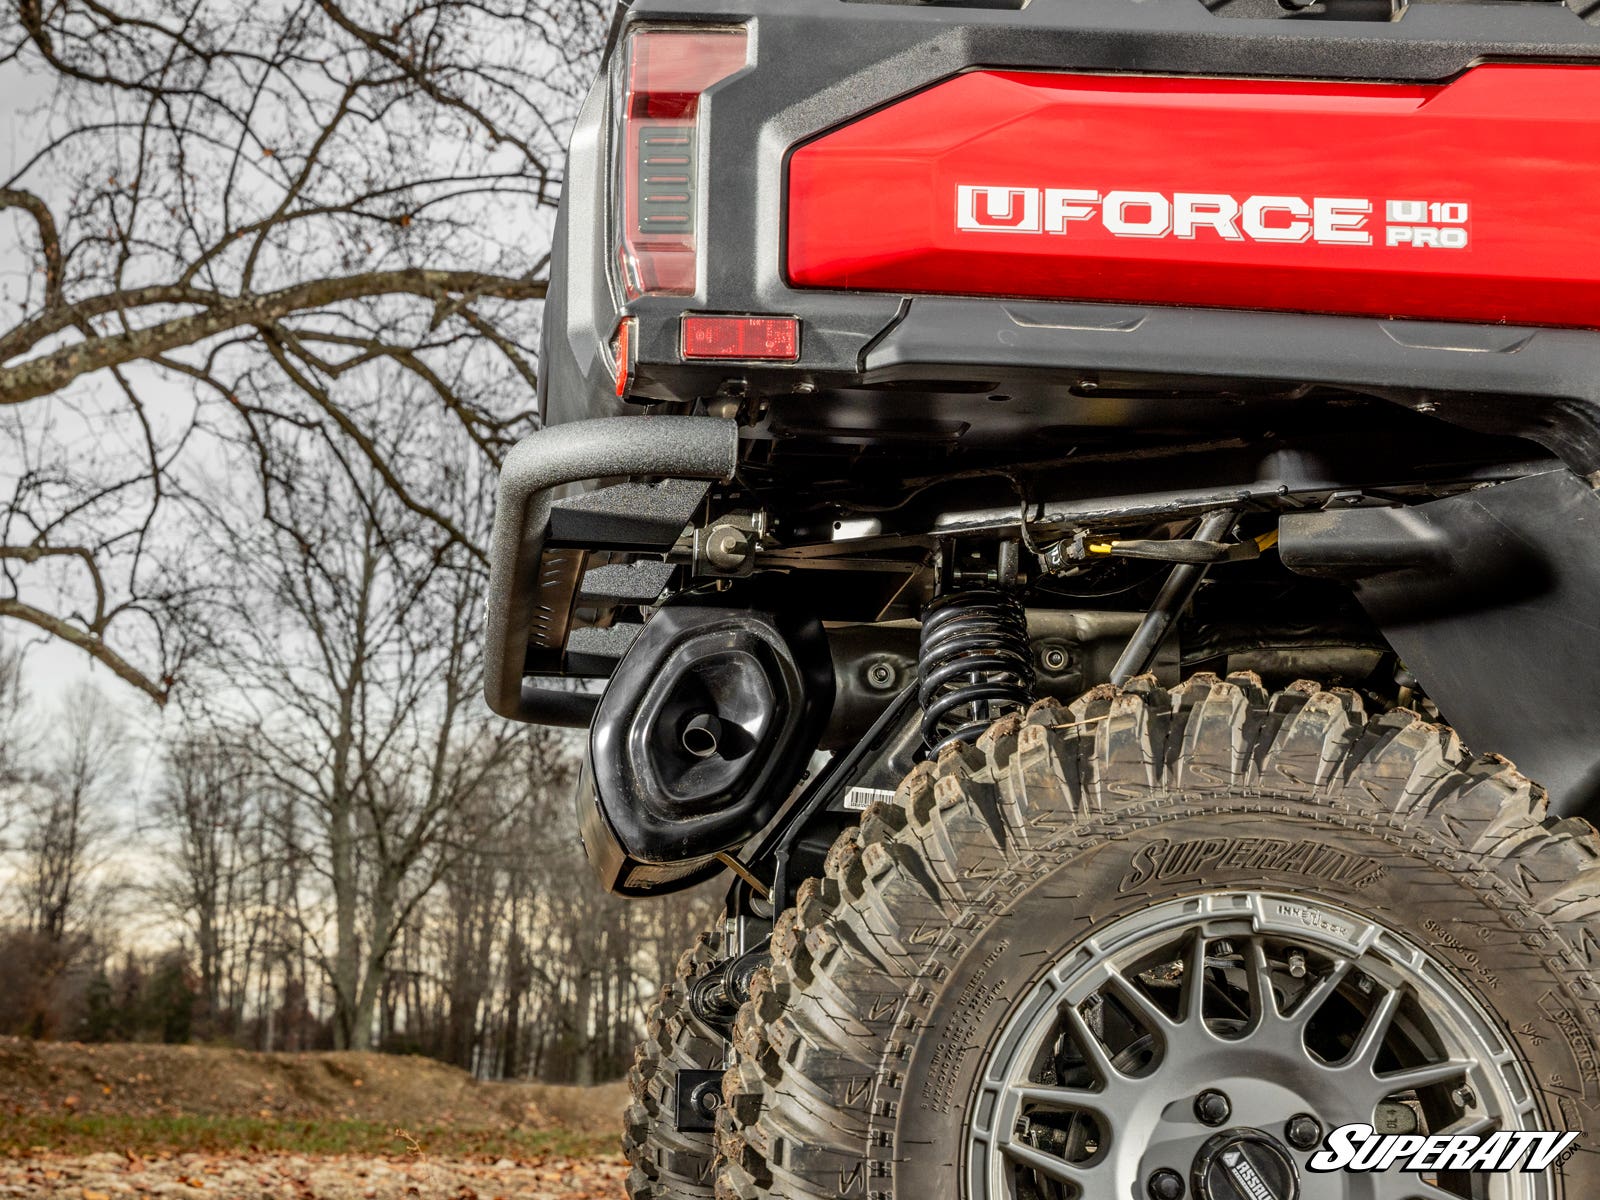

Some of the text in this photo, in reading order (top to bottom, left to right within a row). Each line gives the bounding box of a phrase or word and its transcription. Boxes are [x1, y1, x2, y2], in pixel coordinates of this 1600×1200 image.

[956, 184, 1373, 246] UFORCE
[1386, 199, 1468, 223] U10
[1386, 225, 1468, 249] PRO
[1118, 837, 1383, 892] SUPERATV
[983, 938, 1010, 969] NYLON
